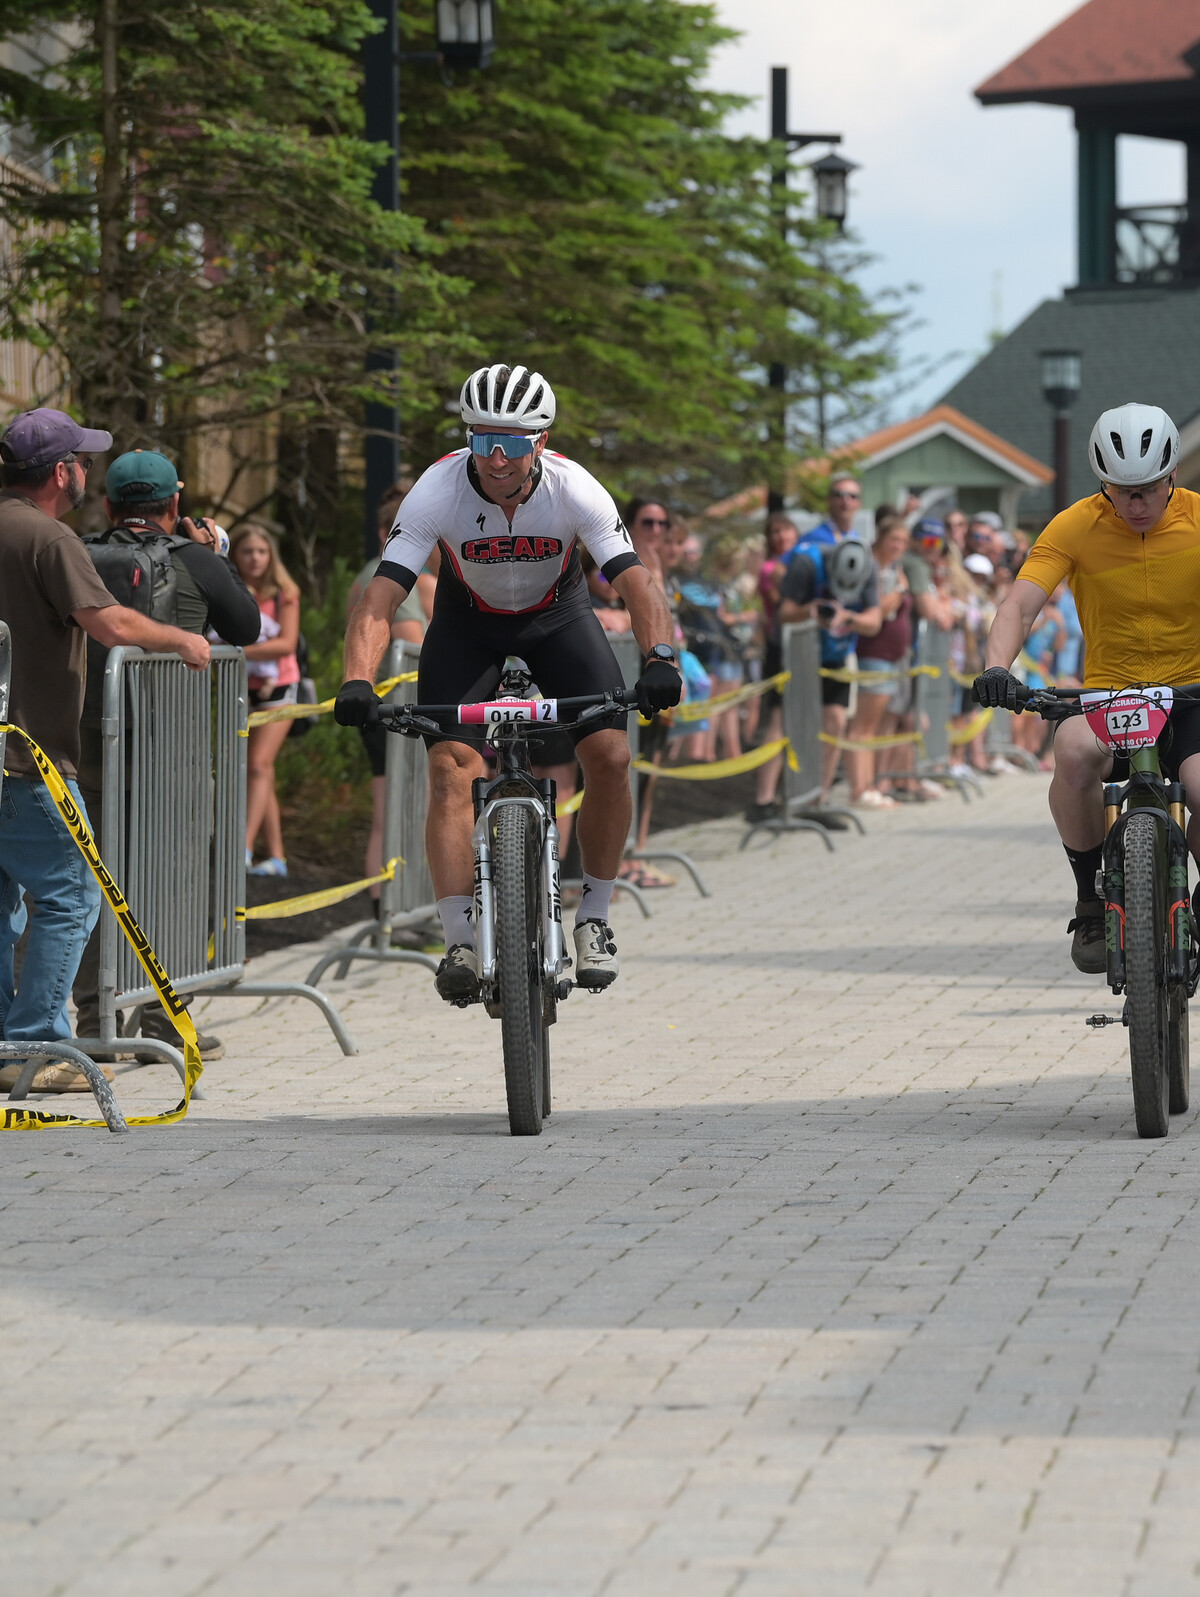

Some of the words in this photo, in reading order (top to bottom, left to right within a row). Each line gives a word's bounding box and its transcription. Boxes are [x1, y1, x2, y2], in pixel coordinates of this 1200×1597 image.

[465, 537, 559, 560] GEAR
[467, 556, 517, 564] BICYCLE
[490, 710, 525, 722] 016
[541, 703, 553, 721] 2
[1111, 712, 1142, 730] 123
[1105, 909, 1117, 953] FOX
[1177, 908, 1189, 951] FOX
